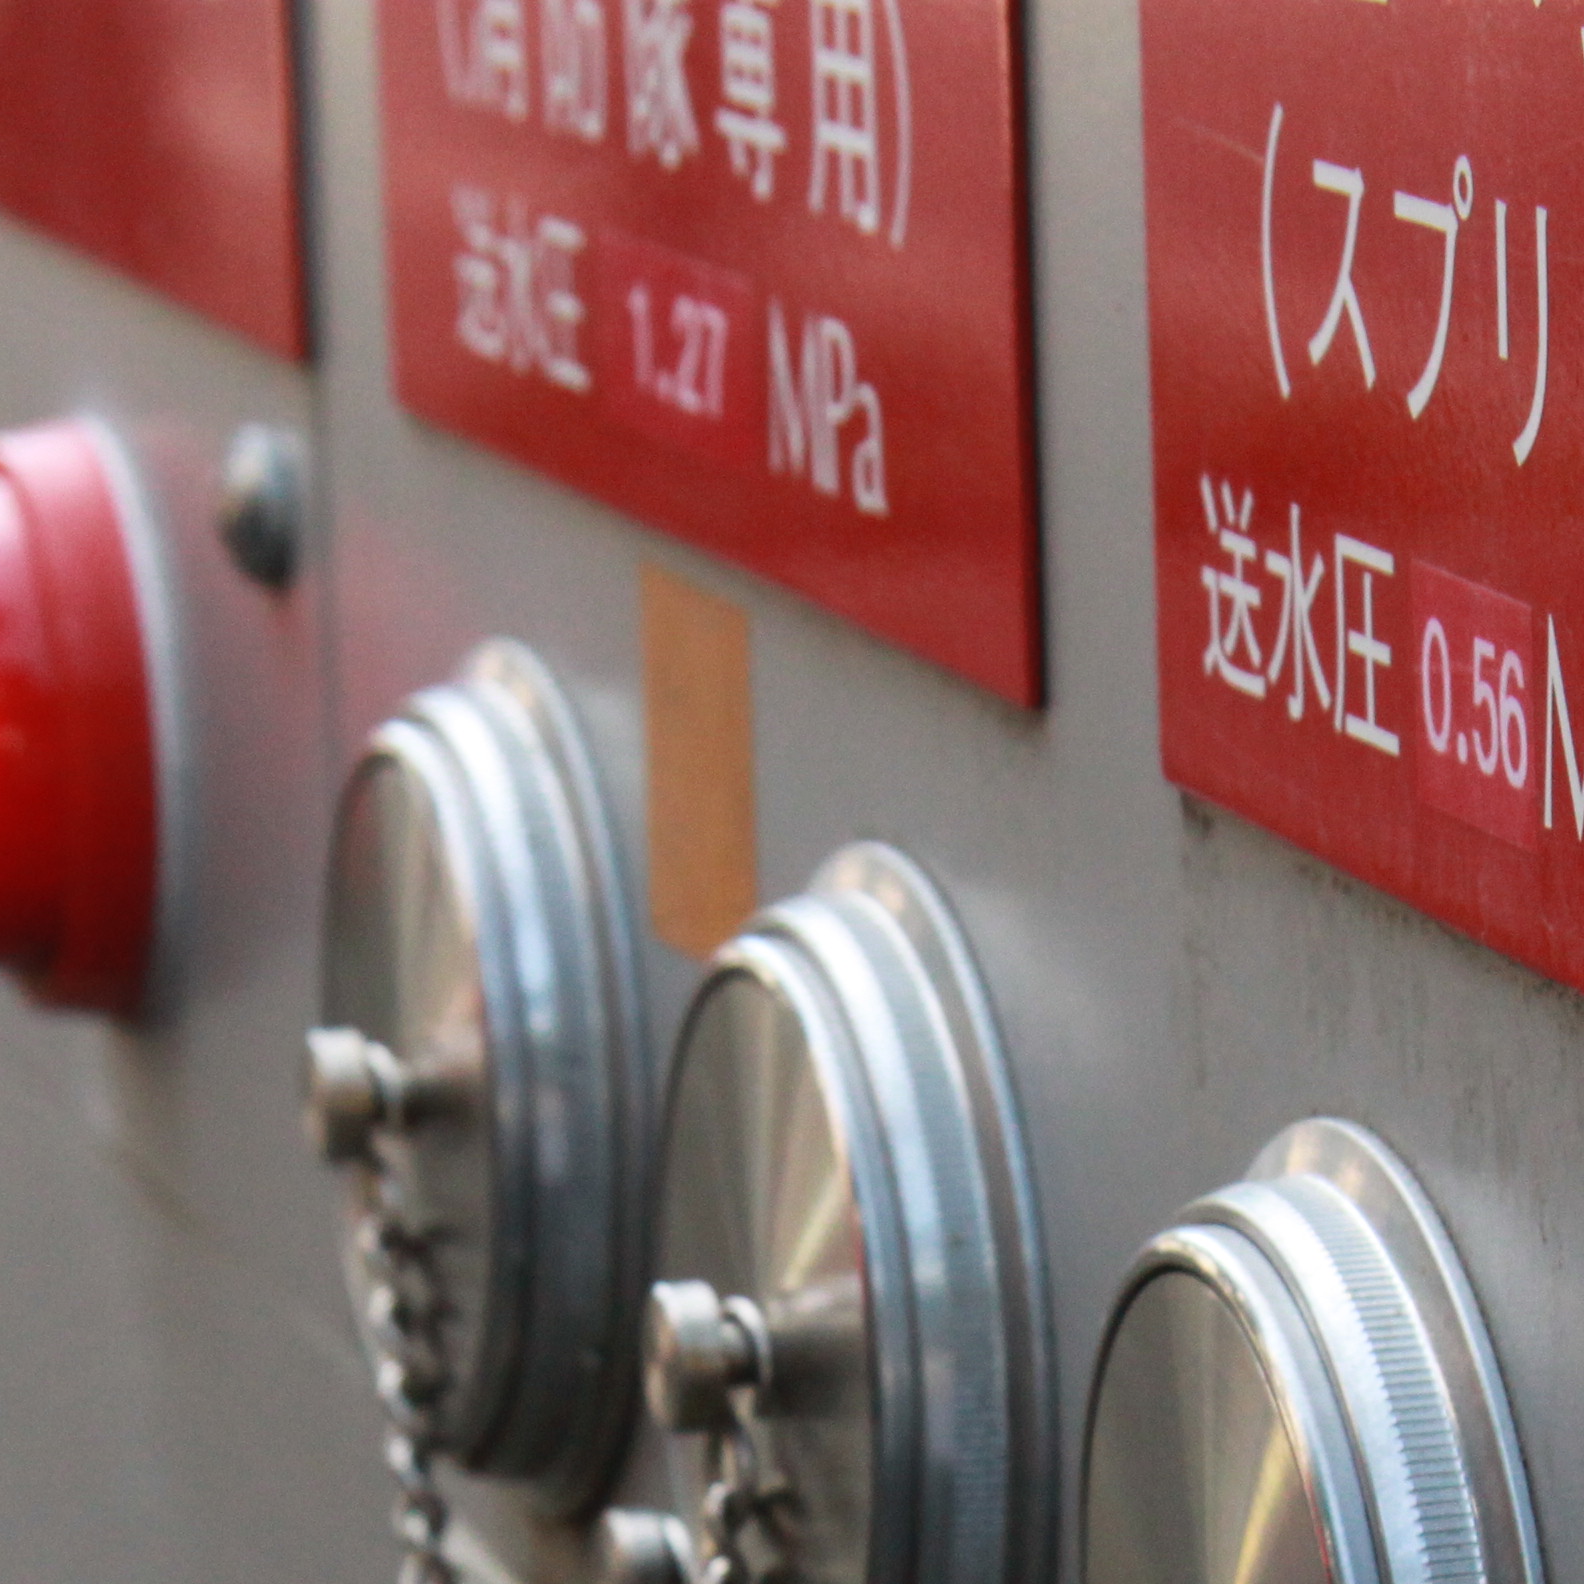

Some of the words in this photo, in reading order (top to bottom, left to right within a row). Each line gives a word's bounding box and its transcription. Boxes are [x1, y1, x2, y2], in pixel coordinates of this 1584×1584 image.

[627, 284, 729, 417] 1.27
[767, 294, 889, 517] MPa
[1200, 474, 1400, 757] 送水圧
[1420, 616, 1529, 789] 0.56
